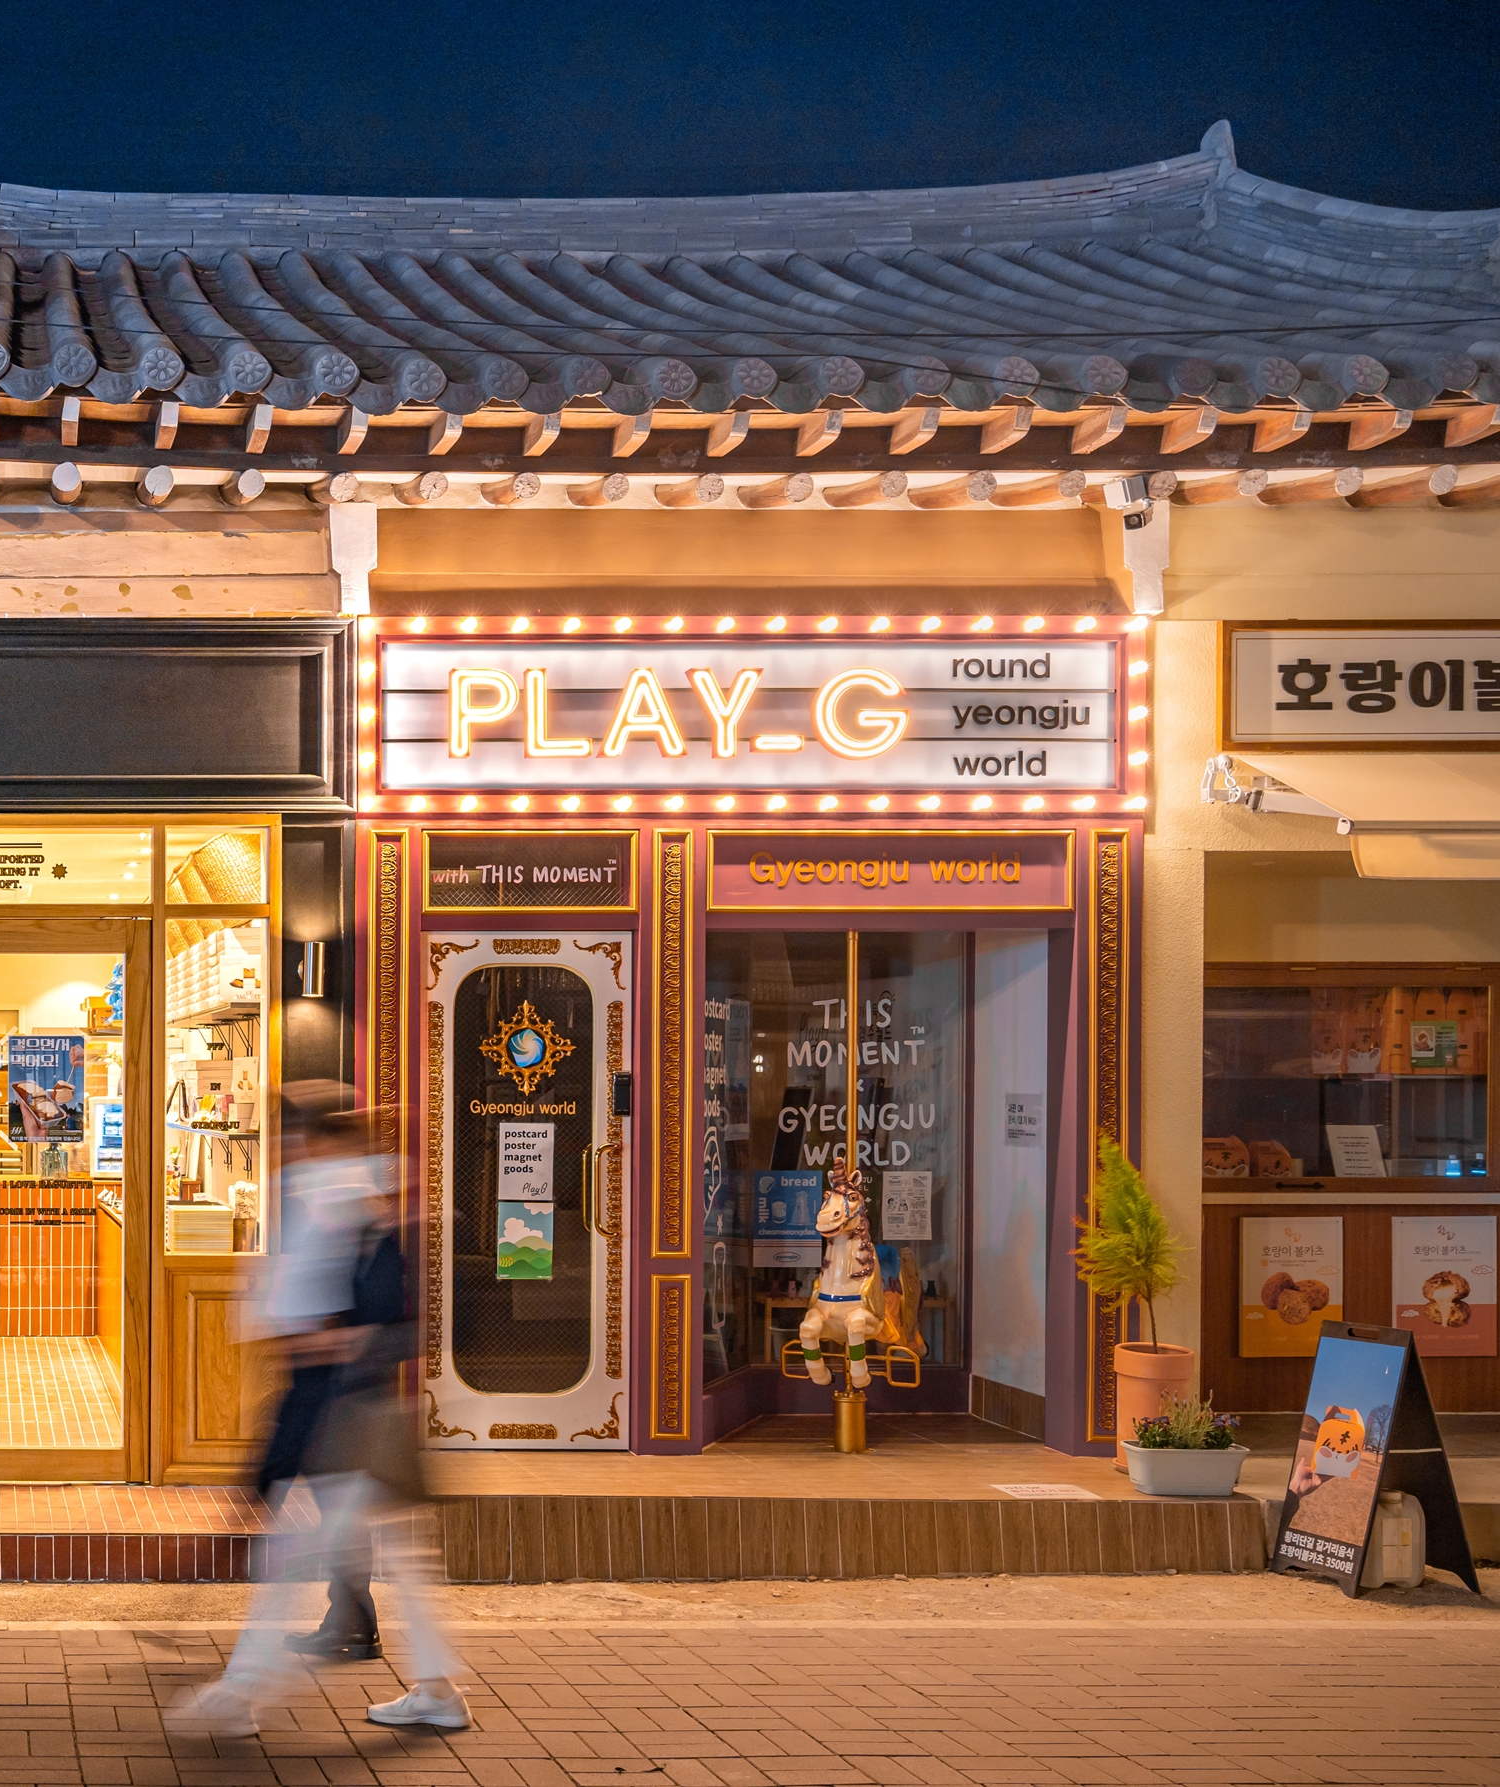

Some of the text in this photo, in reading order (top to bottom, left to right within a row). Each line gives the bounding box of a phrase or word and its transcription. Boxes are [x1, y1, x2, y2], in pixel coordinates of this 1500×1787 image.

[952, 652, 1050, 679] round
[952, 701, 1091, 729] yeongju
[952, 750, 1048, 777] world
[29, 867, 41, 877] IT
[432, 865, 469, 884] with
[475, 864, 524, 884] THIS
[533, 866, 617, 884] MOMENT
[749, 850, 1022, 888] Gyeongju world
[704, 1000, 731, 1021] ostcard
[207, 1042, 226, 1051] FFF
[704, 1031, 723, 1051] oster
[9, 1054, 59, 1067] 먹어요!
[704, 1065, 727, 1090] agnet
[210, 1083, 221, 1091] IN
[469, 1099, 577, 1117] Gyeongju world
[704, 1095, 721, 1118] oods
[191, 1121, 240, 1131] GYEONGJU
[504, 1130, 548, 1139] postcard
[504, 1142, 536, 1151] poster
[504, 1154, 542, 1163] magnet
[504, 1165, 534, 1175] goods
[2, 1180, 93, 1189] I LOVE BAGUETTE
[781, 1176, 817, 1187] bread
[758, 1197, 769, 1223] milk
[758, 1228, 816, 1236] cheomseongdae
[1262, 1245, 1325, 1258] 호랑이 볼카츠
[1413, 1245, 1439, 1256] 호랑이
[1441, 1245, 1467, 1256] 볼카츠
[1284, 1531, 1355, 1560] 황리단길 길거리음식
[1279, 1543, 1354, 1574] 호랑이볼카츠 3500원
